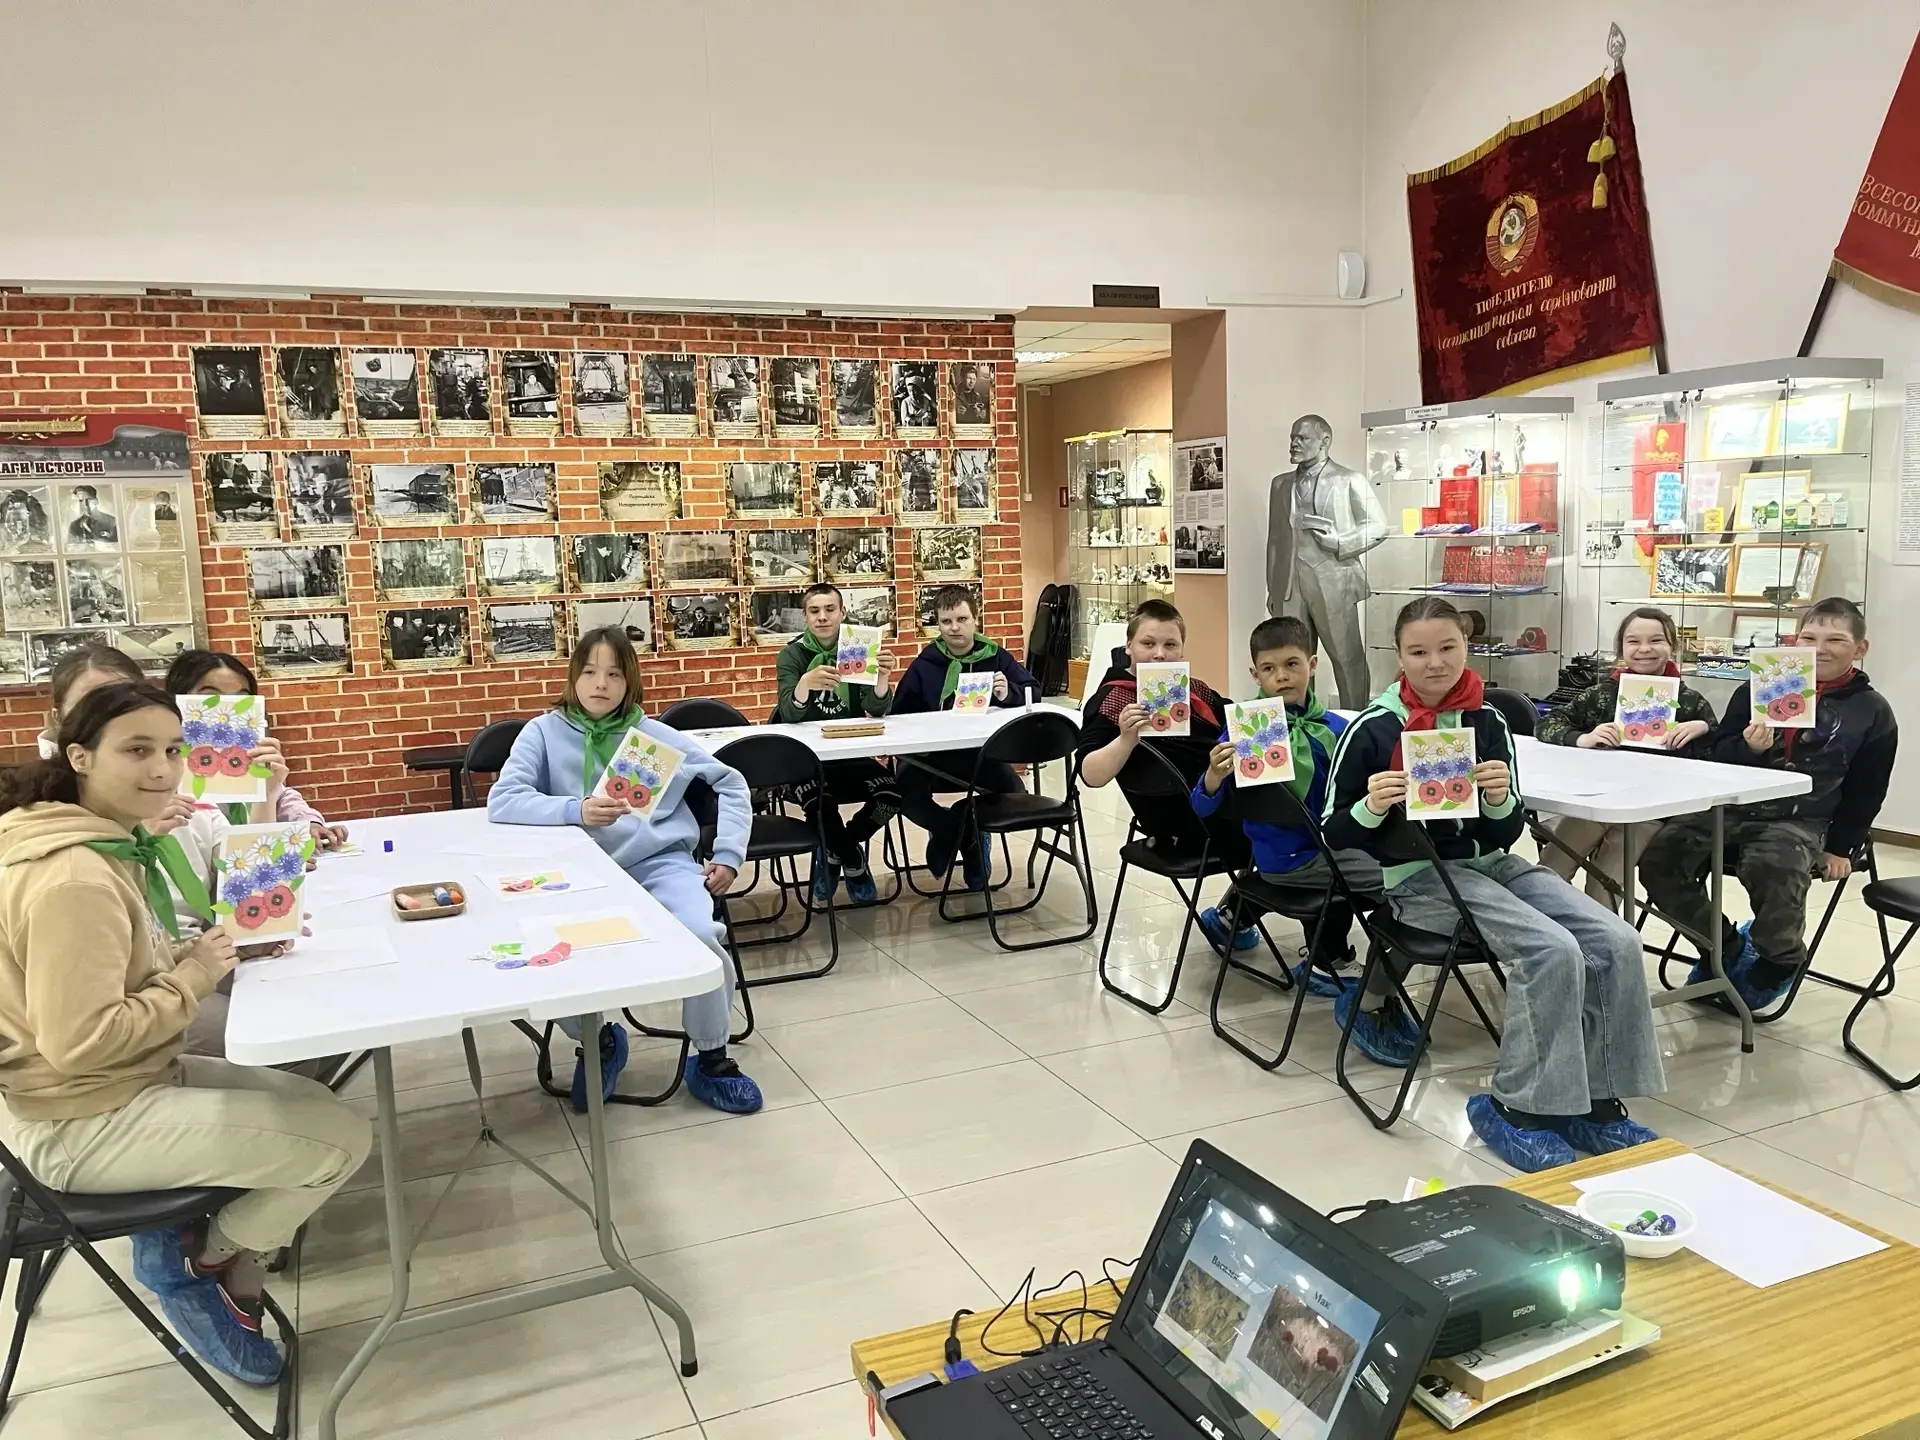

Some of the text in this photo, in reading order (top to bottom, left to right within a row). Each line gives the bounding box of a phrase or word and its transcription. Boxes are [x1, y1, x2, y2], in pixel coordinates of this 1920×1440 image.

[1852, 194, 1920, 236] ОММУН
[0, 460, 104, 474] АГИ ИСТОРИИ
[814, 697, 847, 714] YANKEE
[1512, 1304, 1536, 1318] EPSON
[1195, 1414, 1226, 1440] ASUS
